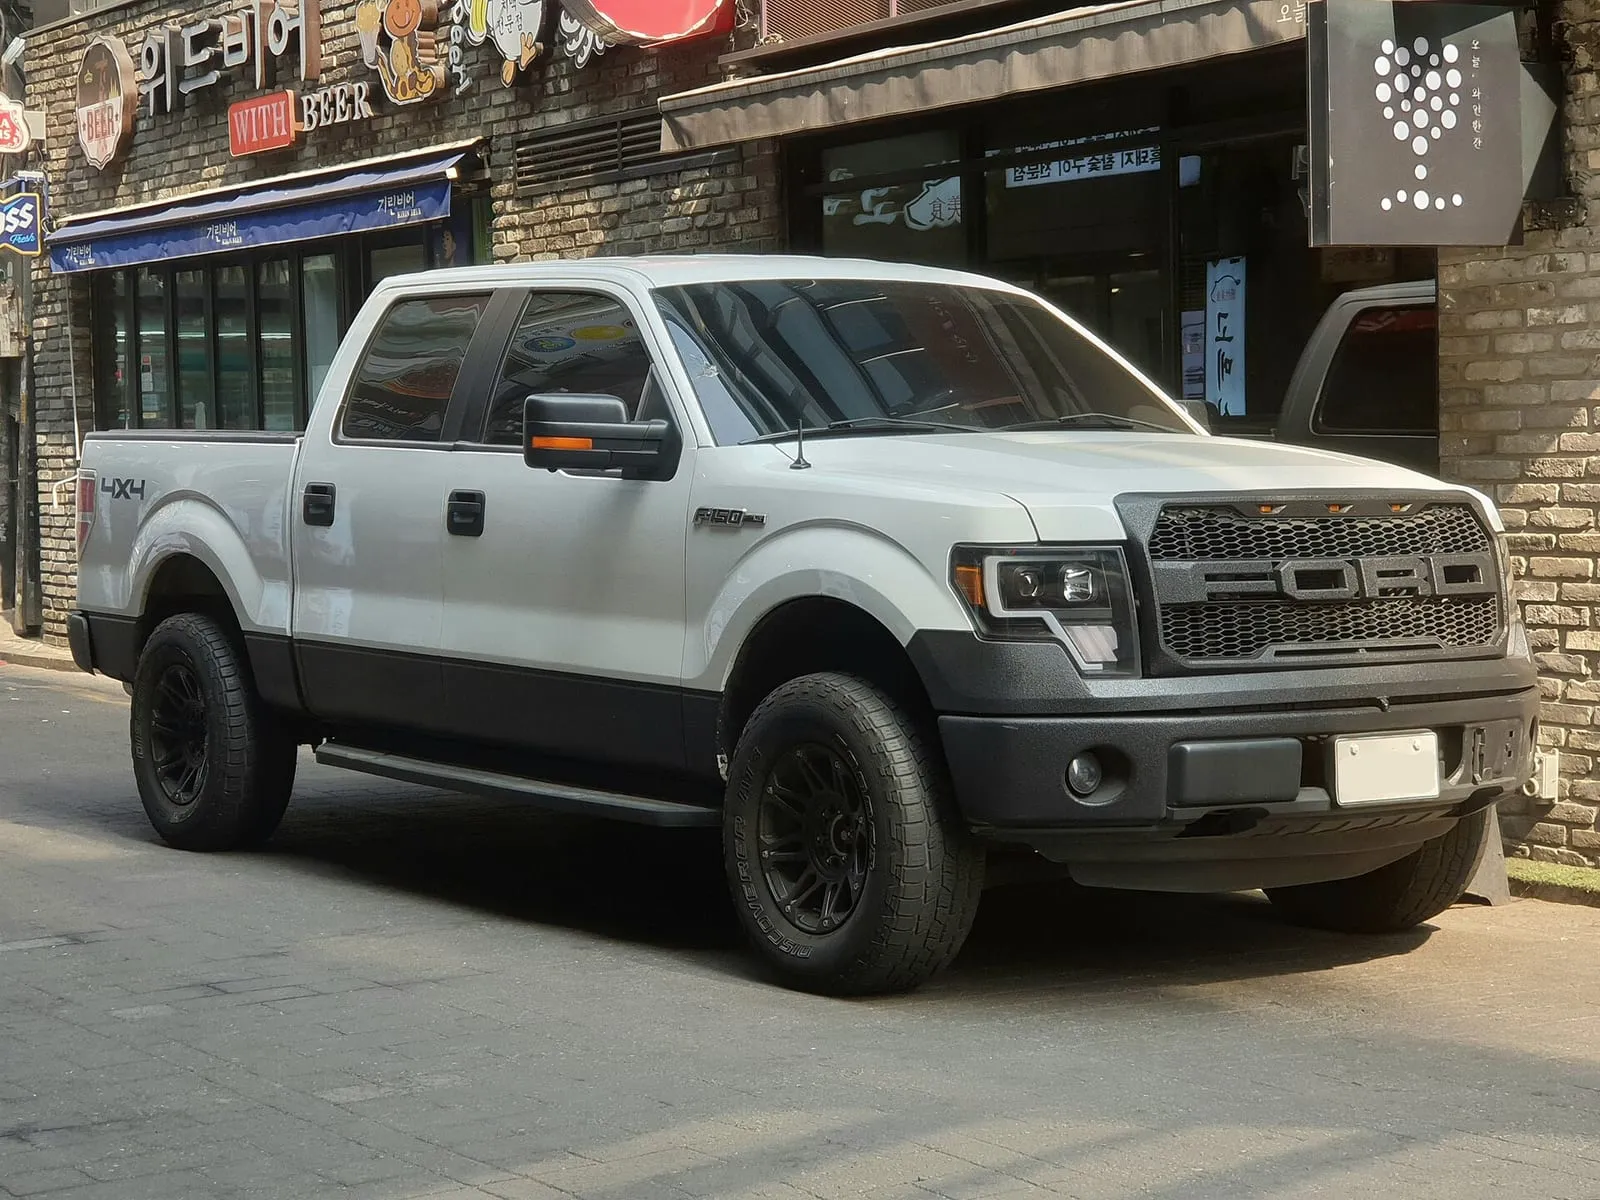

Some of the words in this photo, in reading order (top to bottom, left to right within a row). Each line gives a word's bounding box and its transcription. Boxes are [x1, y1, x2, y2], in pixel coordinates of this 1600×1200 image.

[495, 11, 523, 36] 전문점
[139, 0, 306, 116] 위드비어
[86, 104, 116, 141] BEER
[233, 100, 288, 145] WITH
[301, 81, 374, 132] BEER
[377, 190, 415, 216] 기린비어
[10, 232, 36, 245] Fresh
[206, 221, 237, 243] 기린비어
[65, 244, 93, 263] 기린비어
[101, 477, 146, 500] 4X4
[1152, 556, 1496, 603] FORD
[734, 815, 813, 959] DISCOVERER
